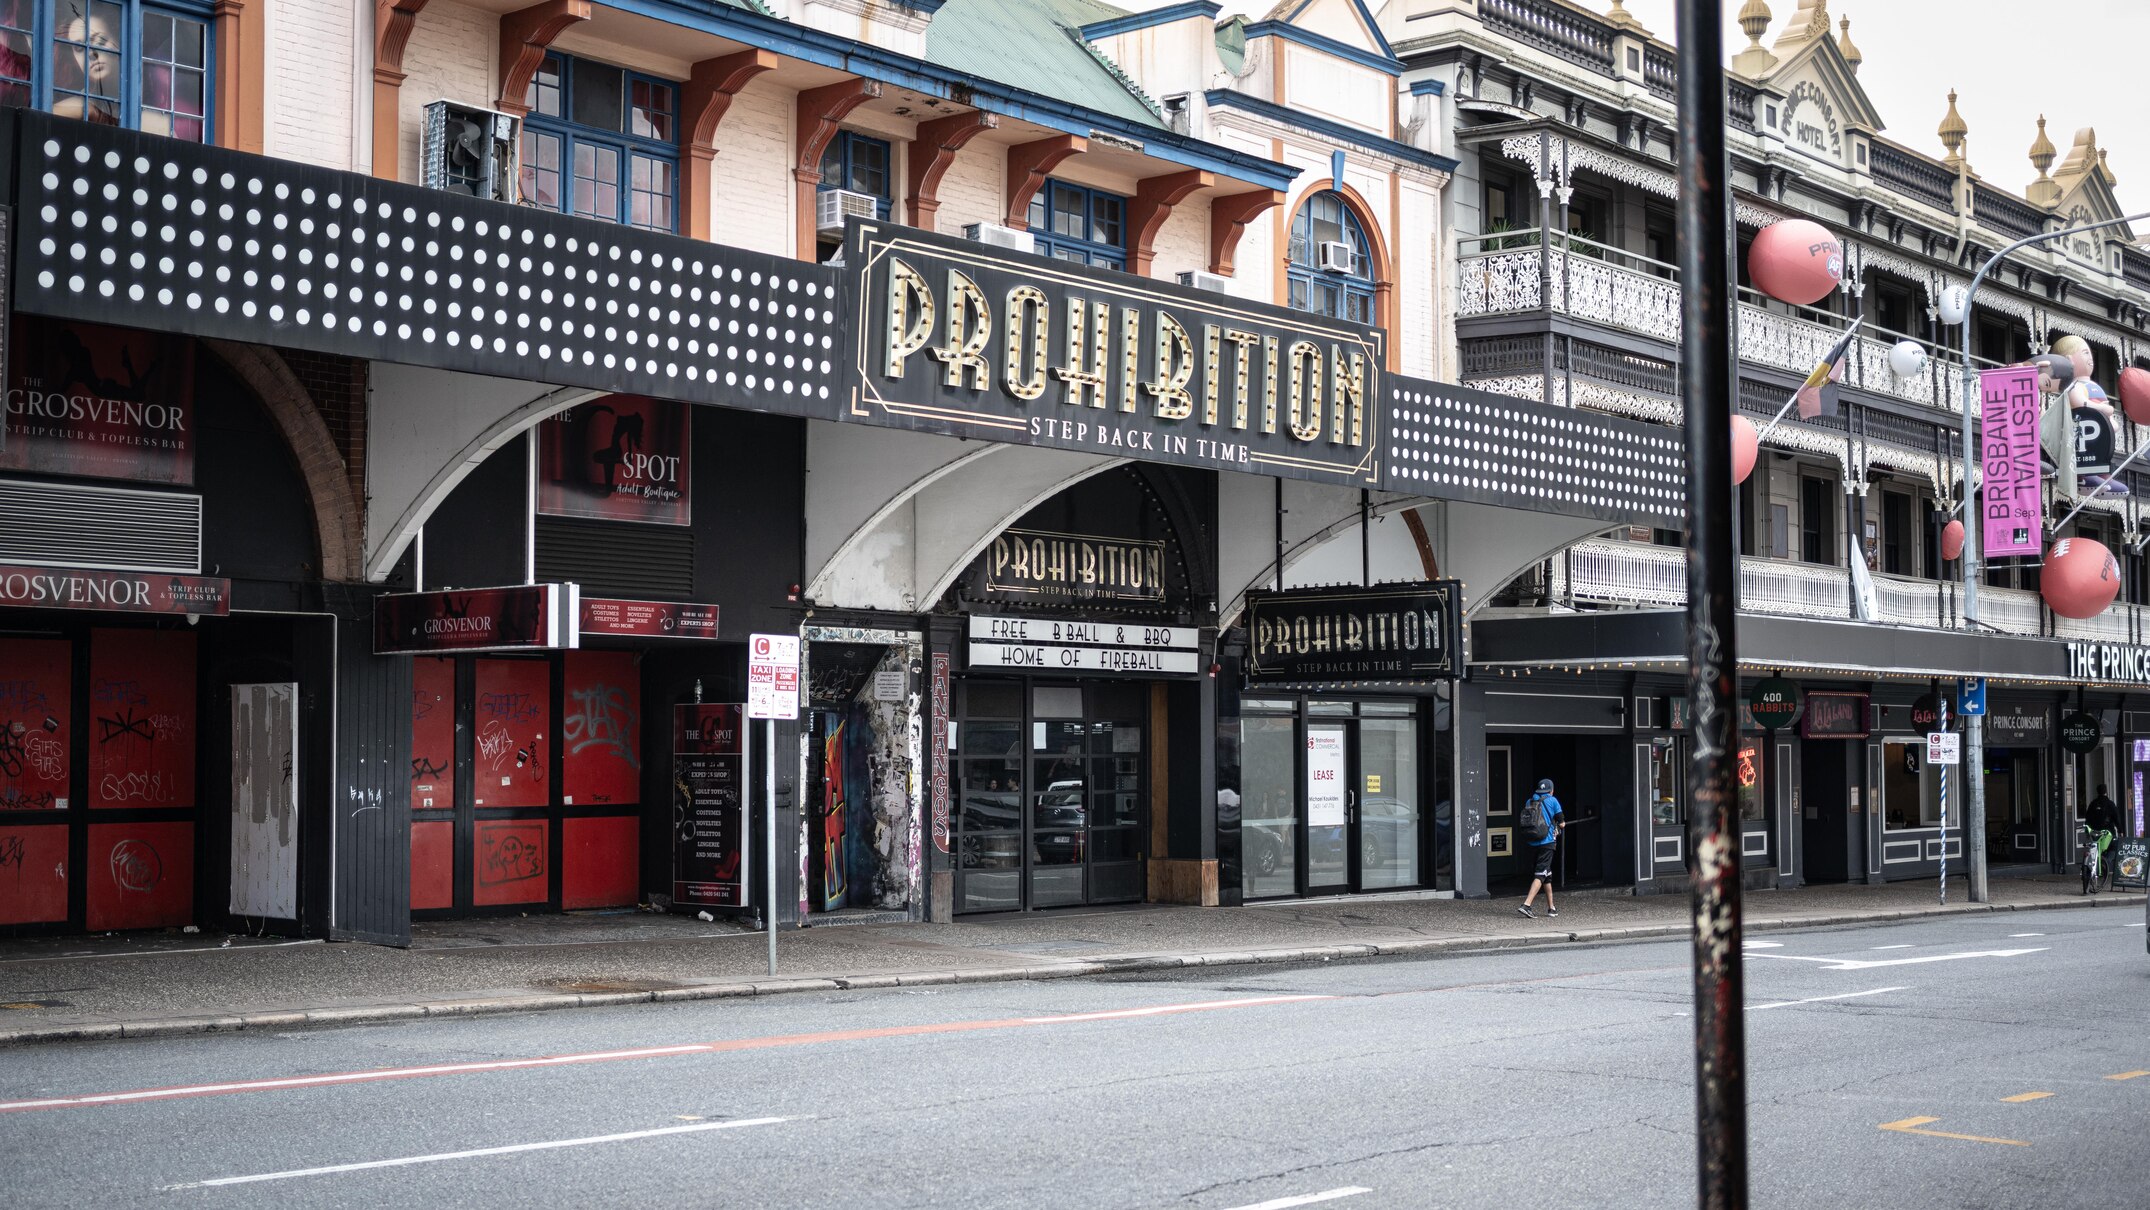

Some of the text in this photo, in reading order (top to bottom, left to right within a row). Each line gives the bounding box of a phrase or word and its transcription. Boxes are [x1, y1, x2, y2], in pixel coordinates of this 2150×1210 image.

[1781, 81, 1842, 160] PRINCE CONSORT
[1797, 121, 1827, 152] HOTEL
[884, 256, 1365, 447] PROHIBITION
[23, 376, 44, 388] THE
[6, 389, 186, 431] GROSVENOR
[549, 408, 572, 422] HE
[6, 424, 185, 450] STRIP CLUB & TOPLESS BAR
[1031, 417, 1248, 464] STEP BACK IN TIME
[2012, 378, 2035, 499] FESTIVAL
[1986, 389, 2010, 519] BRISBANE
[623, 451, 680, 482] SPOT
[617, 482, 680, 501] Adult Boutique
[2014, 508, 2036, 520] Sep
[994, 536, 1159, 588] PROHIBITION
[1041, 586, 1116, 599] STEP BACK IN TIME
[425, 616, 491, 633] GROSVENOR
[991, 620, 1028, 638] FREE
[1066, 624, 1100, 642] BALL
[1116, 626, 1125, 643] &
[1144, 628, 1172, 646] BBQ
[1259, 610, 1439, 654] PROHIBITION
[1001, 647, 1163, 670] HOME OF FIREBALL
[1297, 661, 1402, 673] STEP BACK IN TIME
[2068, 643, 2150, 681] THE PRINCE
[752, 666, 772, 674] TAXI
[1763, 692, 1782, 702] 400
[1964, 680, 1978, 697] P
[1753, 703, 1794, 712] RABBITS
[1993, 715, 2043, 729] PRINCE CONSORT
[2063, 728, 2095, 736] PRINCE
[685, 729, 733, 740] THE SPOT
[932, 656, 949, 838] FANDANGOS
[1314, 770, 1334, 780] LEASE
